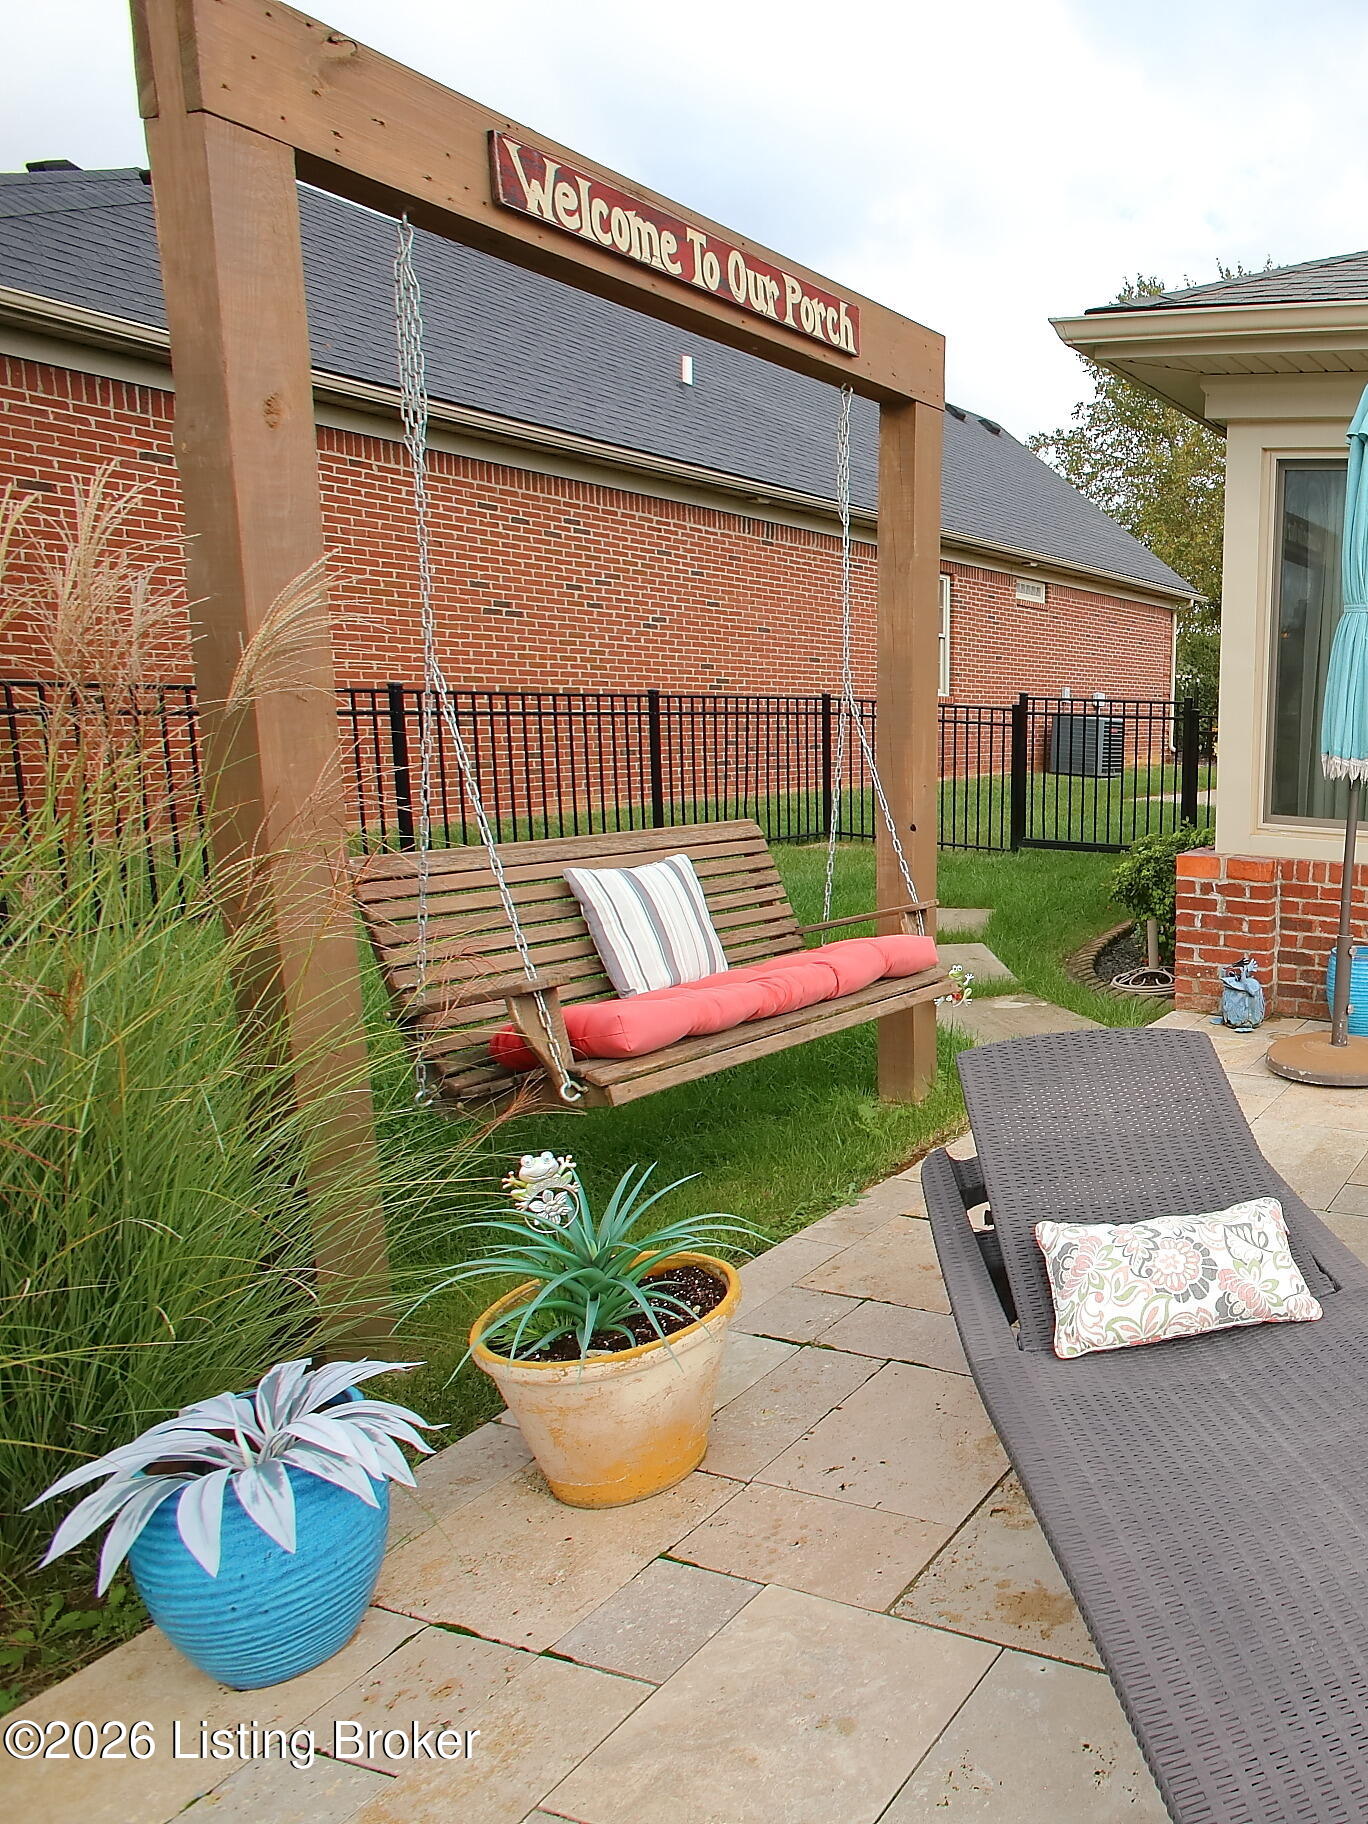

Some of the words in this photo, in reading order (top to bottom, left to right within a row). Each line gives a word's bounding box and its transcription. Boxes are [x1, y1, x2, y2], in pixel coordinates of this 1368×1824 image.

[502, 137, 683, 275] Welcome
[686, 227, 720, 291] To
[727, 250, 780, 319] Our
[782, 273, 857, 354] Porch
